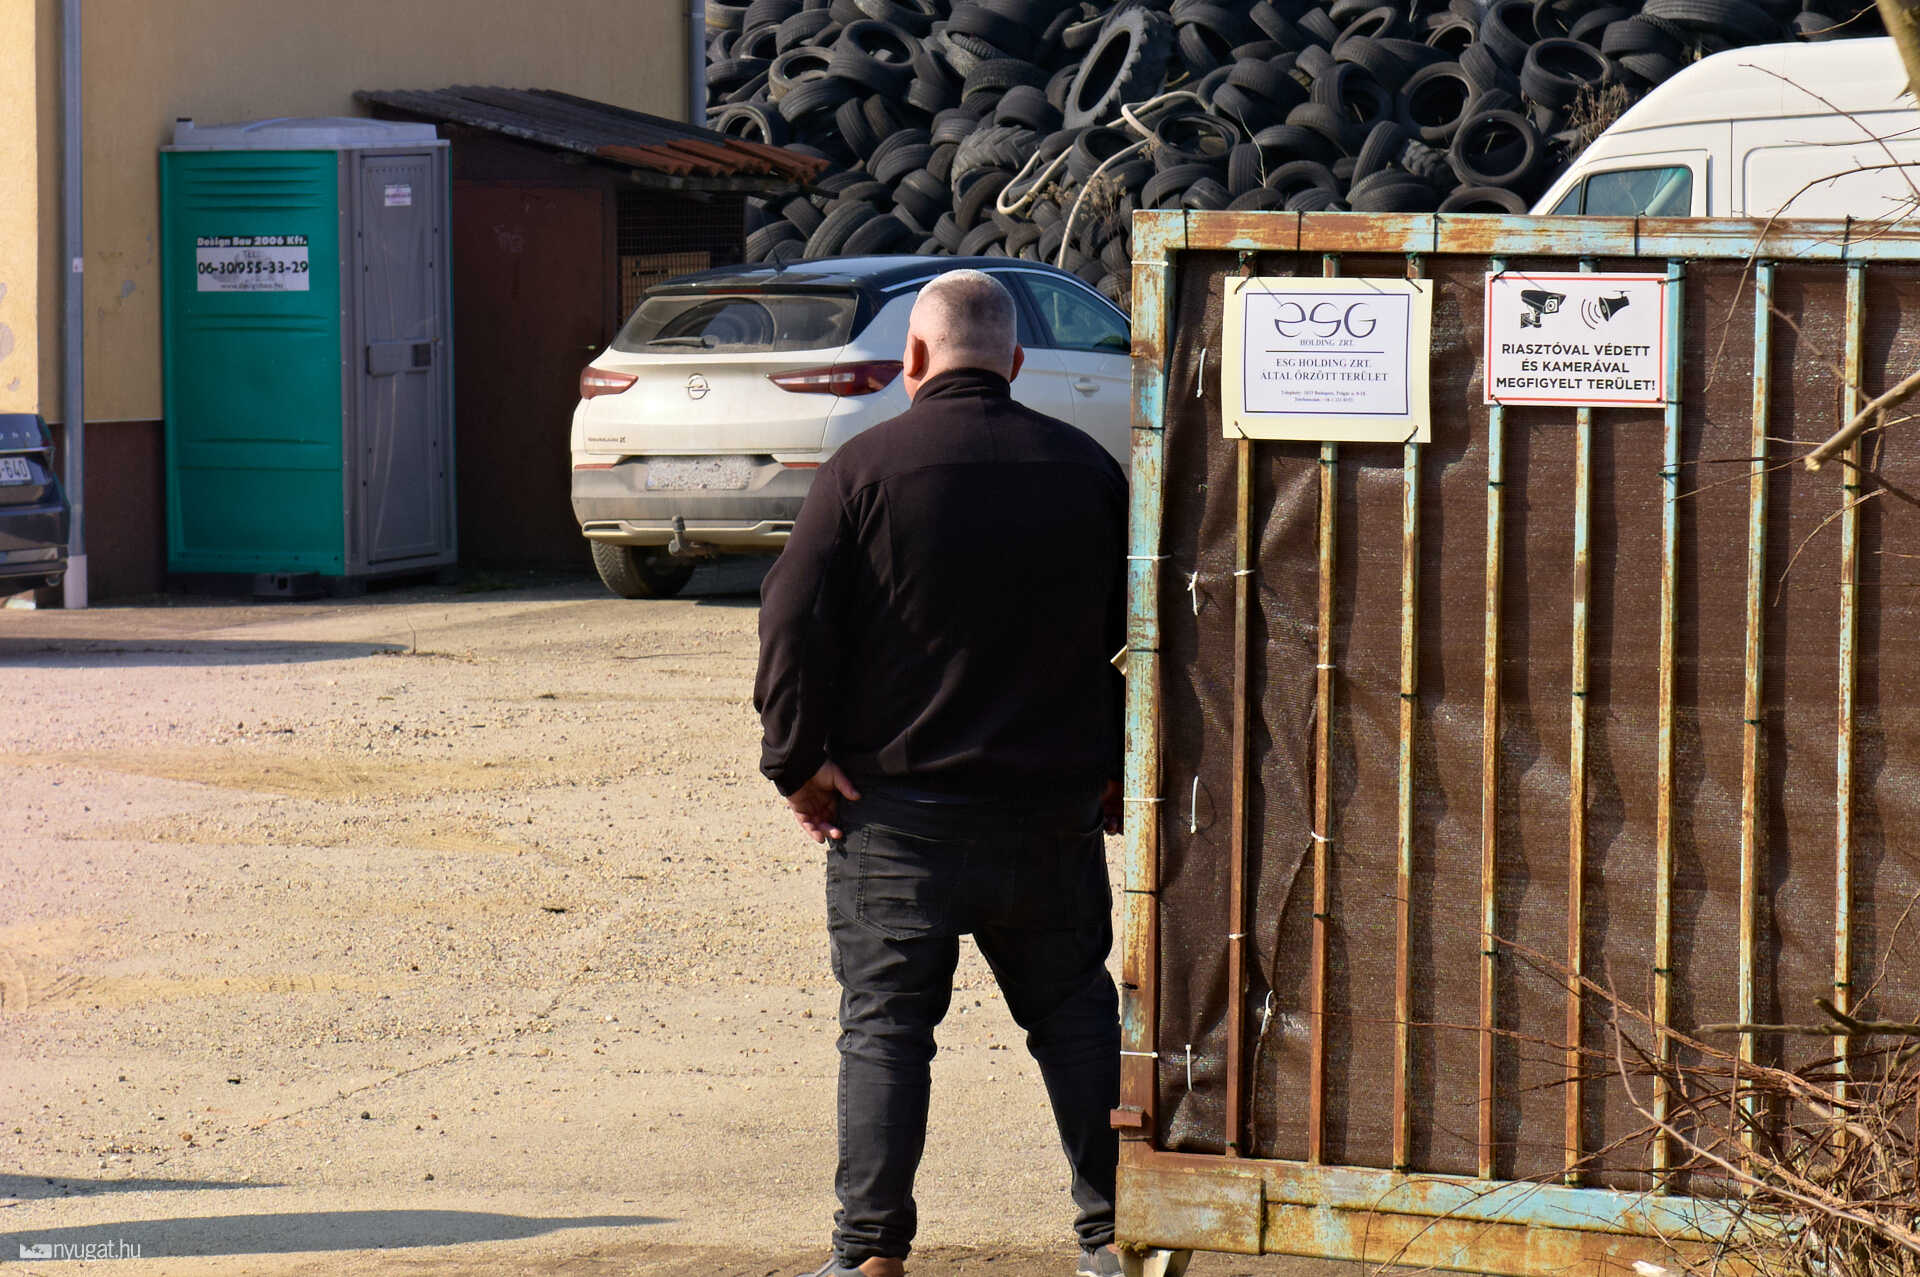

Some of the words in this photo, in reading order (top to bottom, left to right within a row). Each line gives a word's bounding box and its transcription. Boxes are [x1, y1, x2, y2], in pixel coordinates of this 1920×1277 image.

[198, 236, 231, 248] Design
[232, 236, 251, 246] Bau
[253, 236, 284, 246] 2006
[286, 235, 307, 245] Kft.
[1502, 342, 1590, 355] RIASZTÓVAL
[1594, 343, 1650, 357] VÉDETT
[1276, 358, 1296, 367] ESG
[1299, 359, 1347, 368] HOLDING
[1521, 358, 1538, 371] ÉS
[1542, 359, 1630, 373] KAMERÁVAL
[1261, 369, 1292, 380] ÁLTAL
[1341, 370, 1389, 381] TERÜLET
[1496, 377, 1583, 389] MEGFIGYELT
[1587, 377, 1656, 391] TERÜLET!
[0, 459, 29, 478] -640
